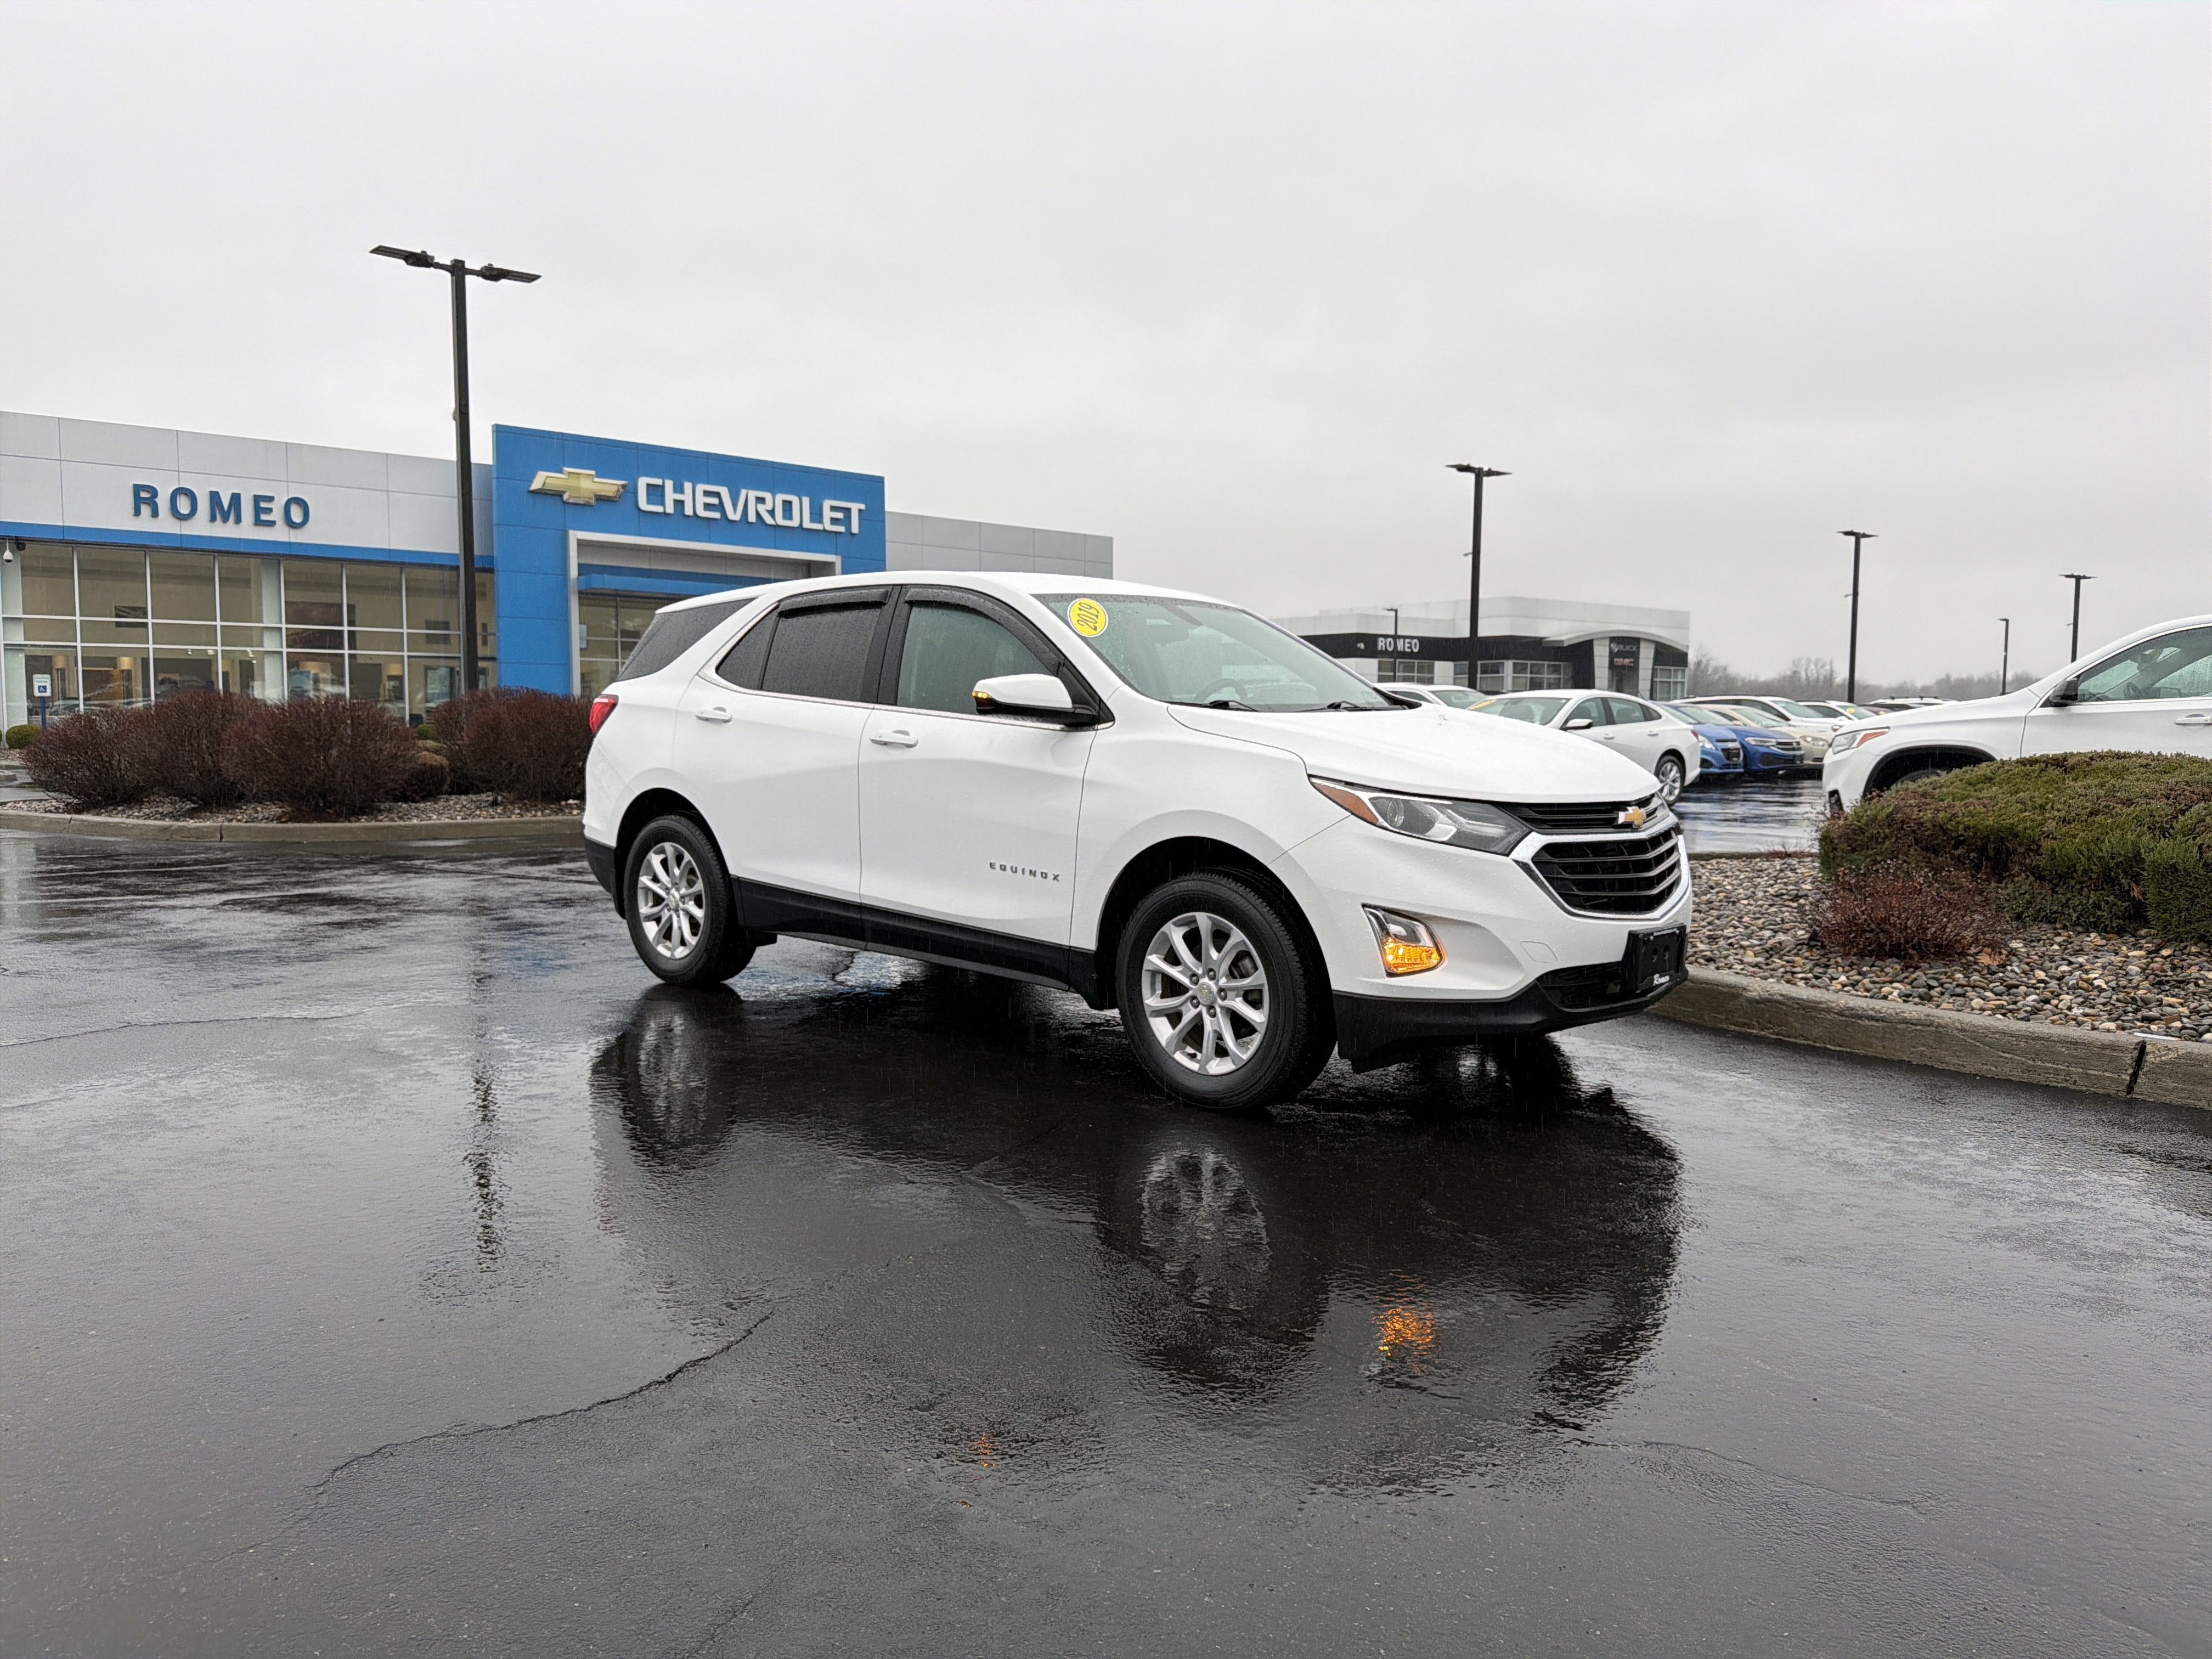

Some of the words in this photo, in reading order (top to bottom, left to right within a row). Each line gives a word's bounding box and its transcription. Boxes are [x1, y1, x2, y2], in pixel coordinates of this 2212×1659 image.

[133, 483, 310, 529] ROMEO
[637, 476, 866, 534] CHEVROLET
[1077, 602, 1099, 631] 2019
[1377, 637, 1419, 653] ROMEO
[989, 862, 1060, 882] EQUINOX
